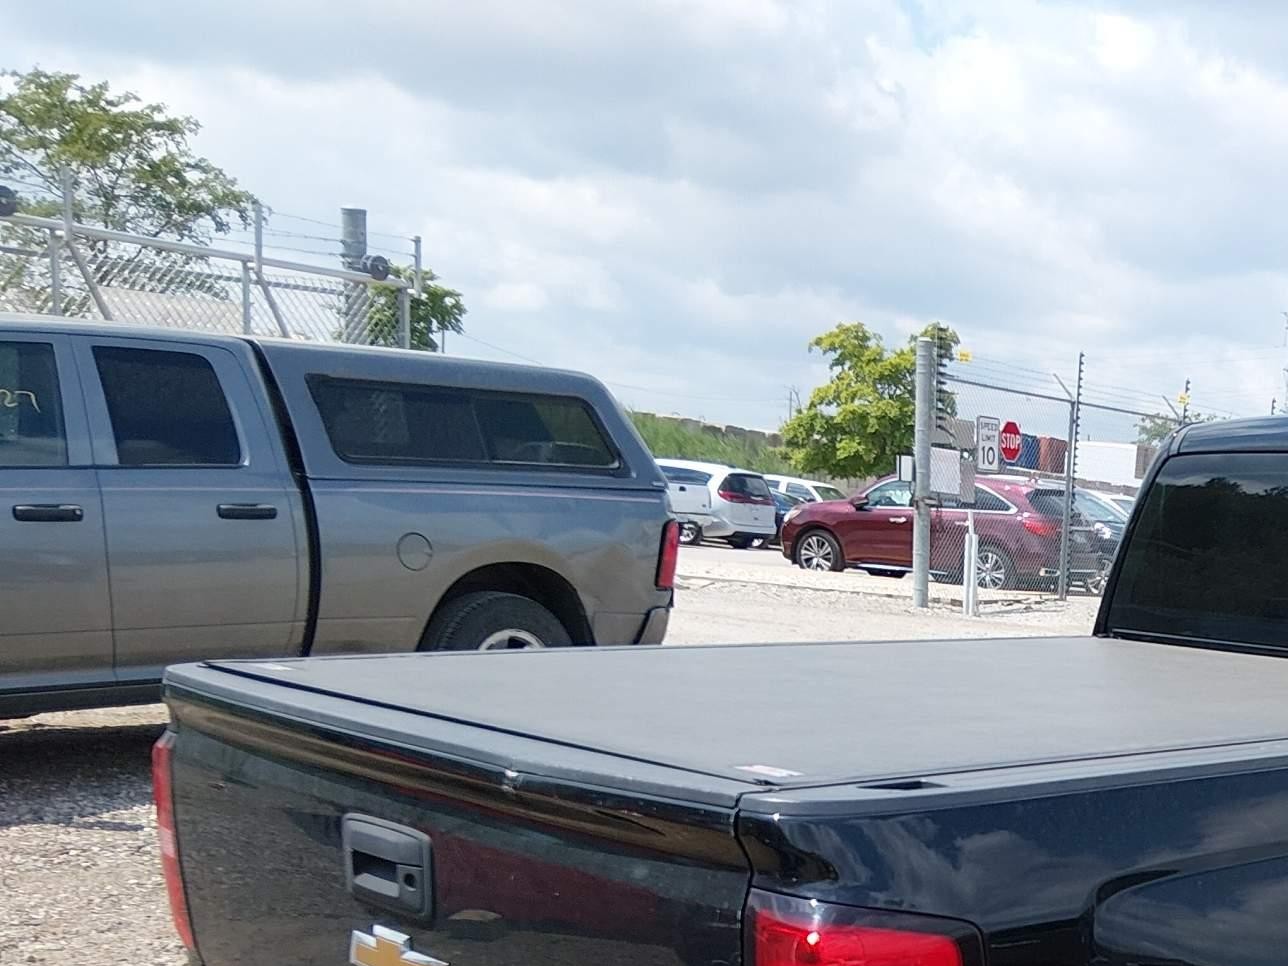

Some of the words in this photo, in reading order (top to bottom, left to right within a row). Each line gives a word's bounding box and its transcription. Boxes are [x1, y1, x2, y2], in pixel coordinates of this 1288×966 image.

[981, 421, 998, 431] SPEED
[981, 433, 996, 442] LIMIT
[1001, 432, 1020, 450] STOP
[982, 446, 995, 465] 10
